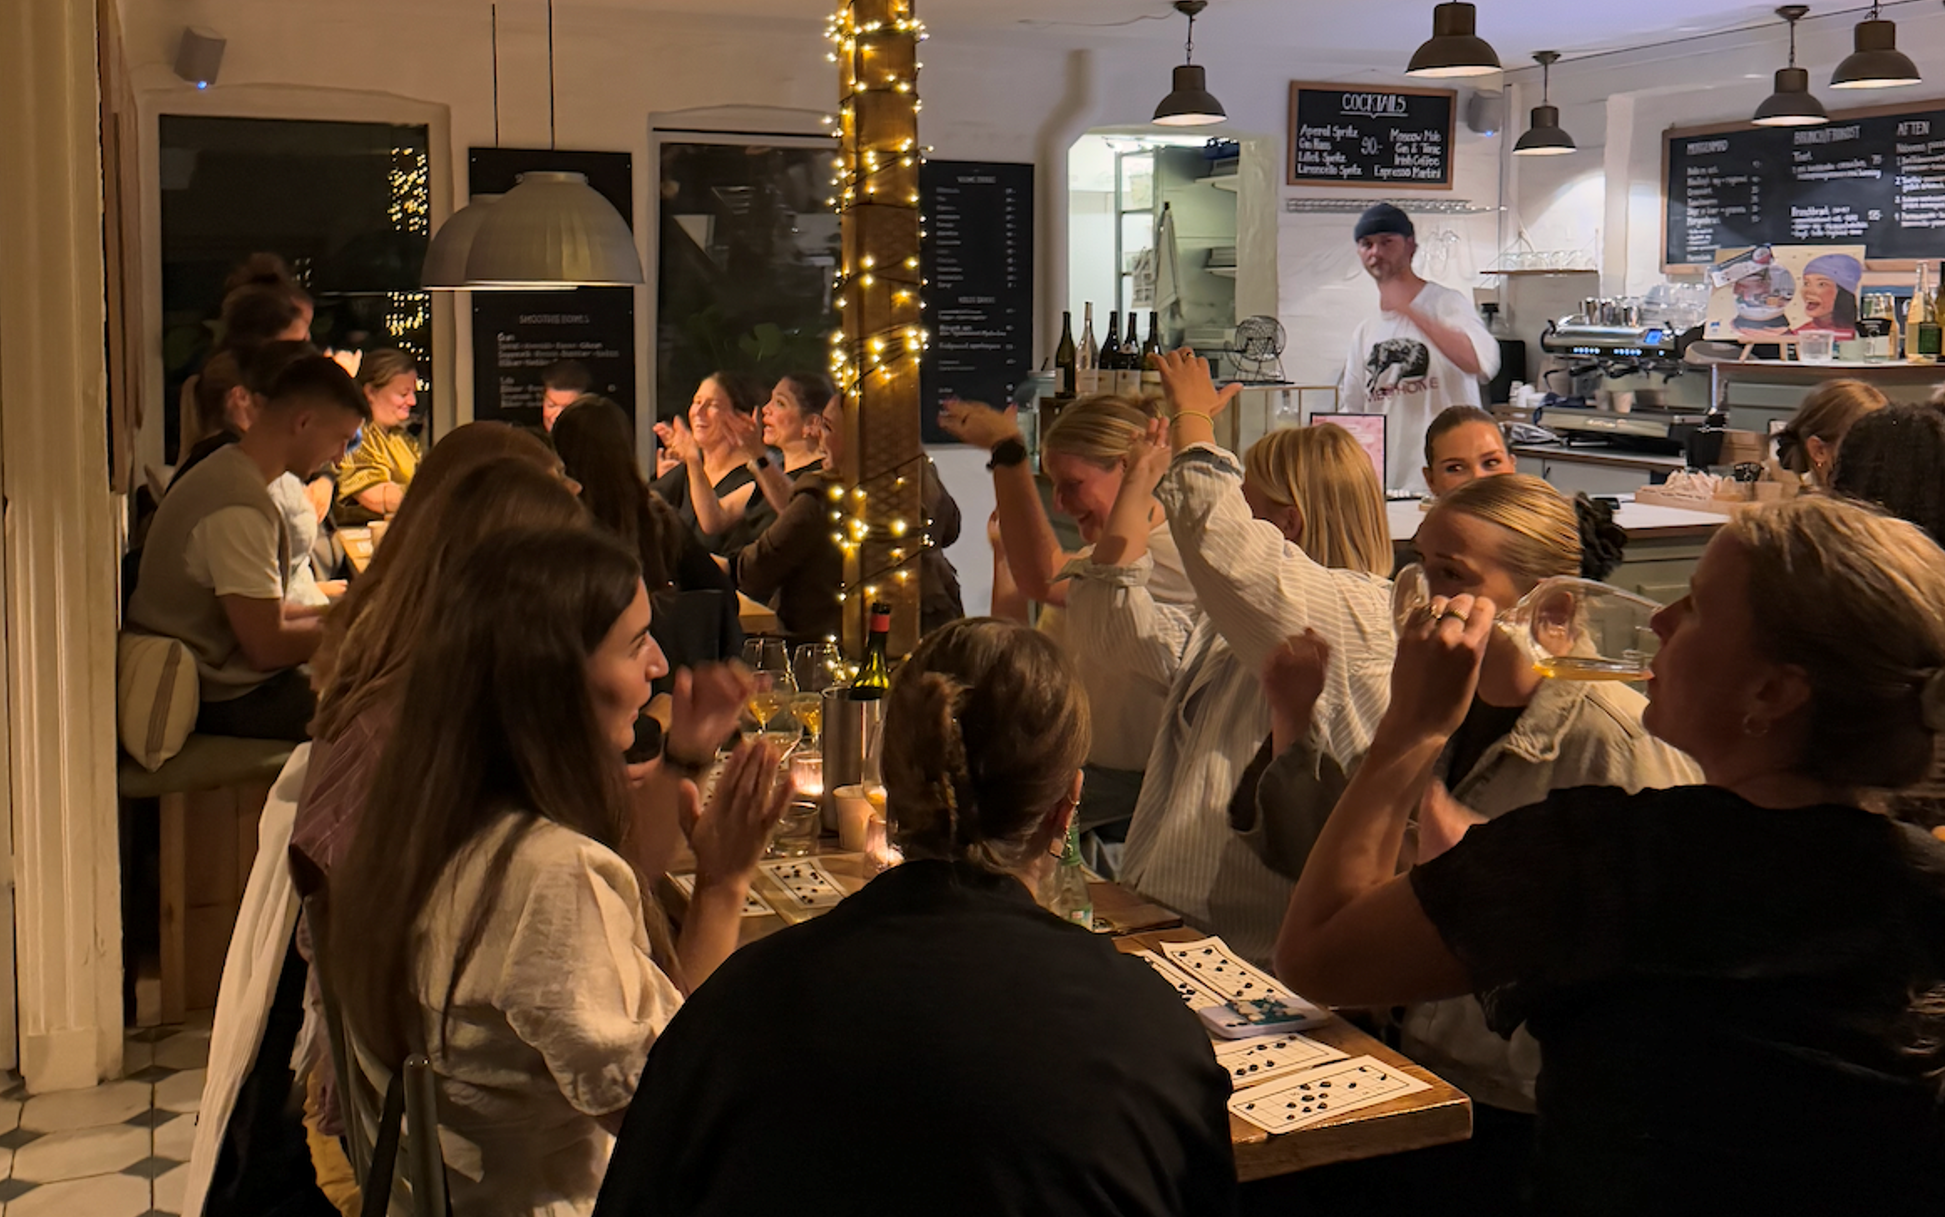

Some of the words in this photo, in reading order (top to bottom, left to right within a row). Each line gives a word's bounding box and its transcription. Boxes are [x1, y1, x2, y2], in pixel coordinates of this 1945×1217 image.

[1342, 93, 1406, 113] COCKTAILS
[1299, 124, 1331, 139] Aperol
[1332, 125, 1359, 141] Spritz
[1389, 128, 1422, 142] Moscow
[1896, 121, 1930, 138] AFTEN
[1419, 143, 1441, 155] Tonic
[1321, 152, 1347, 166] Spritz
[1338, 164, 1363, 179] Spritz
